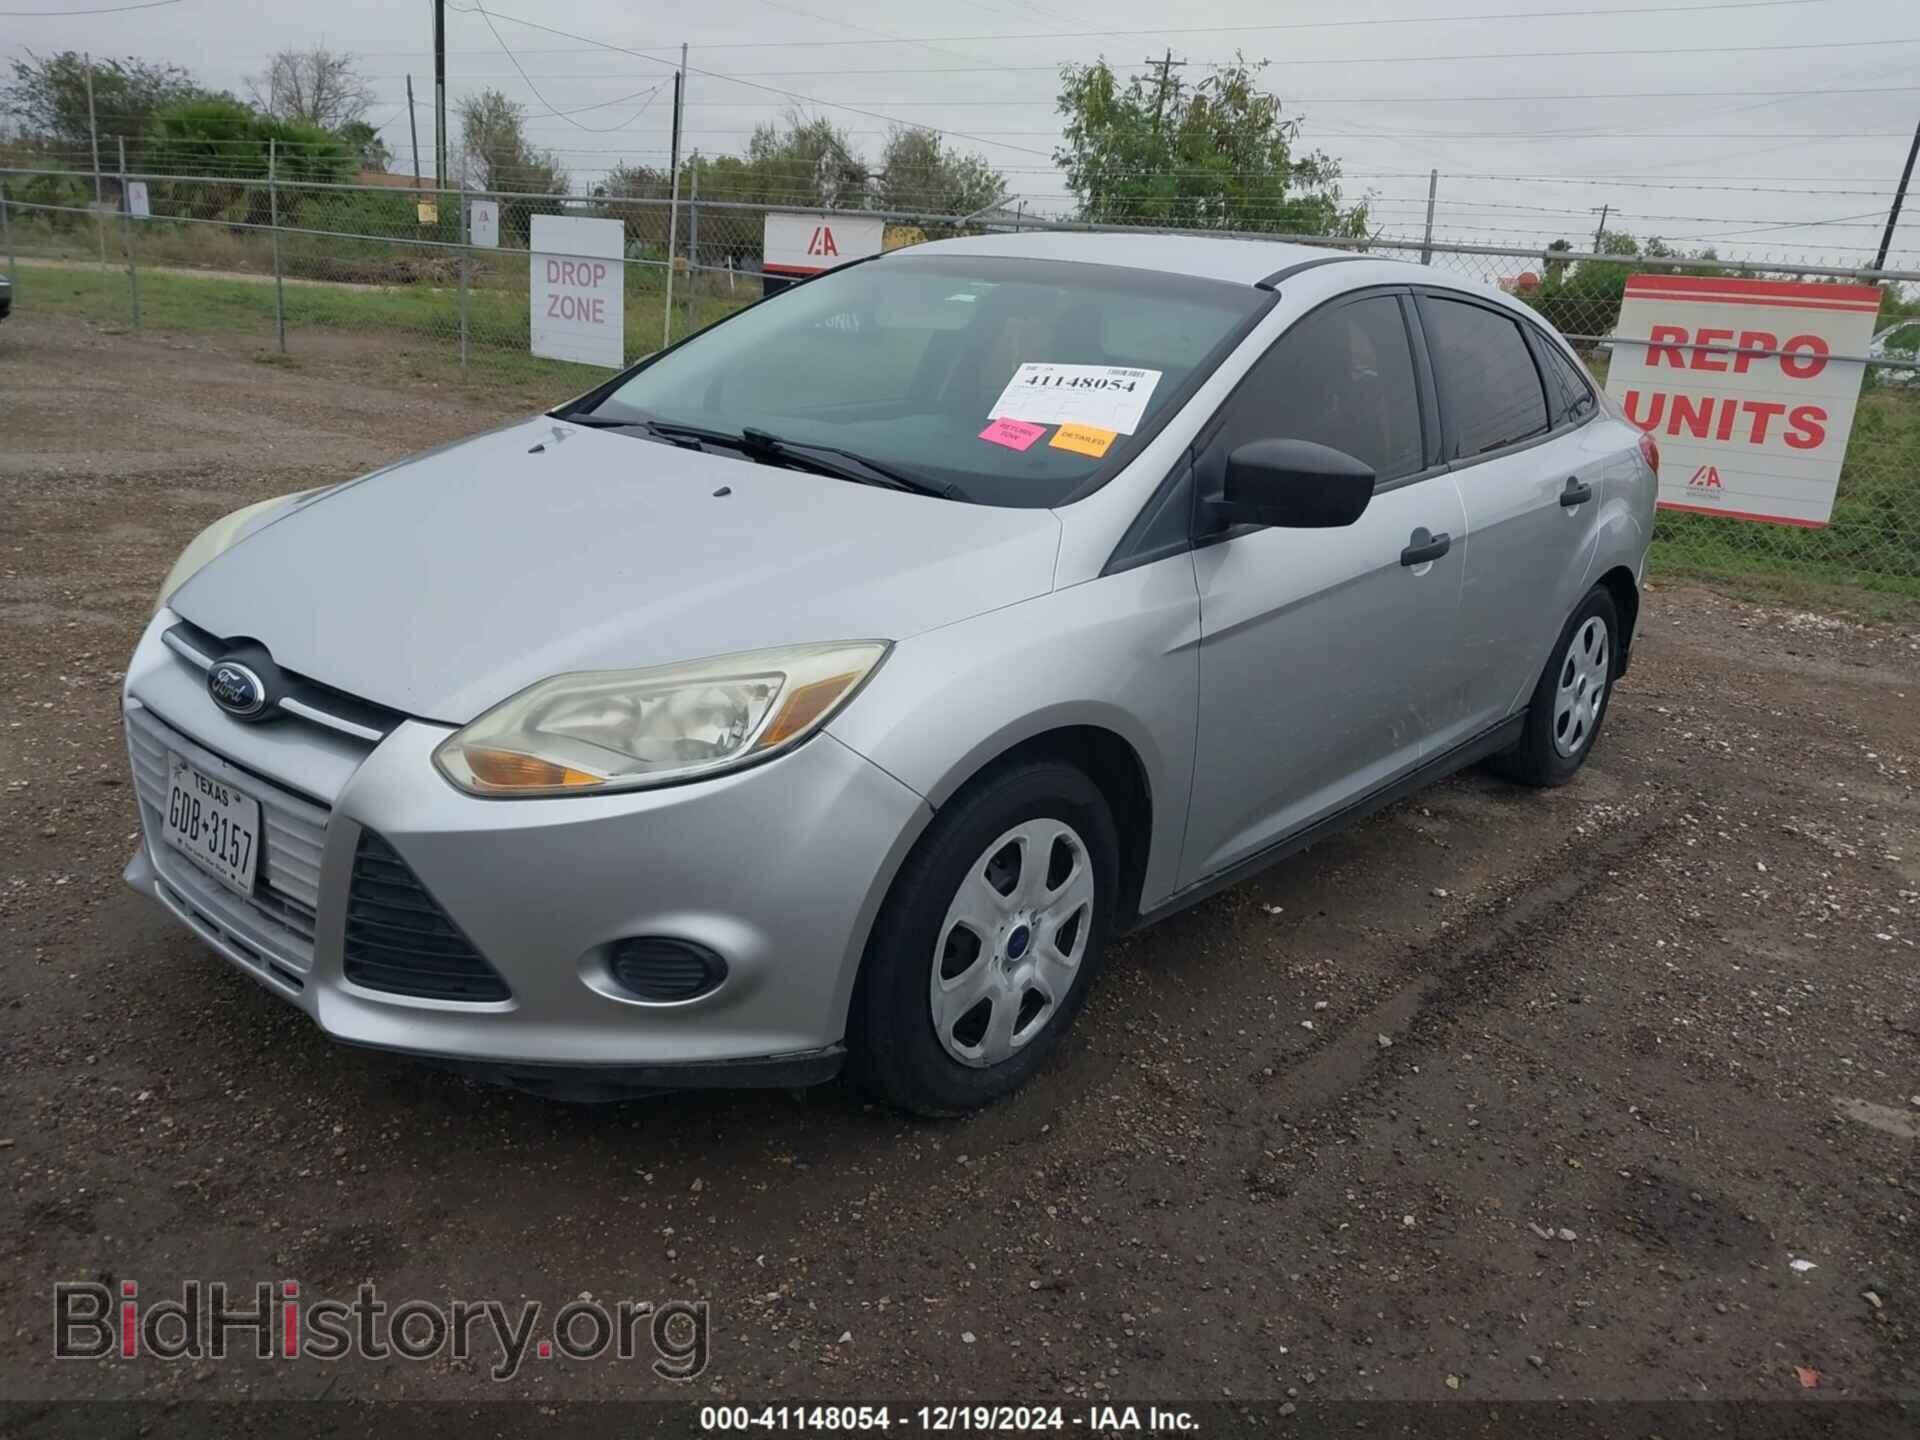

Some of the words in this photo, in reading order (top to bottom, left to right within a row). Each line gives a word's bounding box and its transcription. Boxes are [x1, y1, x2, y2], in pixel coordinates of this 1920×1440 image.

[546, 259, 606, 288] DROP
[546, 294, 605, 324] ZONE
[1645, 325, 1830, 379] REPO
[1024, 374, 1137, 393] 41148054
[1623, 390, 1828, 449] UNITS
[1061, 431, 1106, 446] DETAILED
[212, 668, 246, 703] Ford
[193, 771, 229, 807] TEXAS
